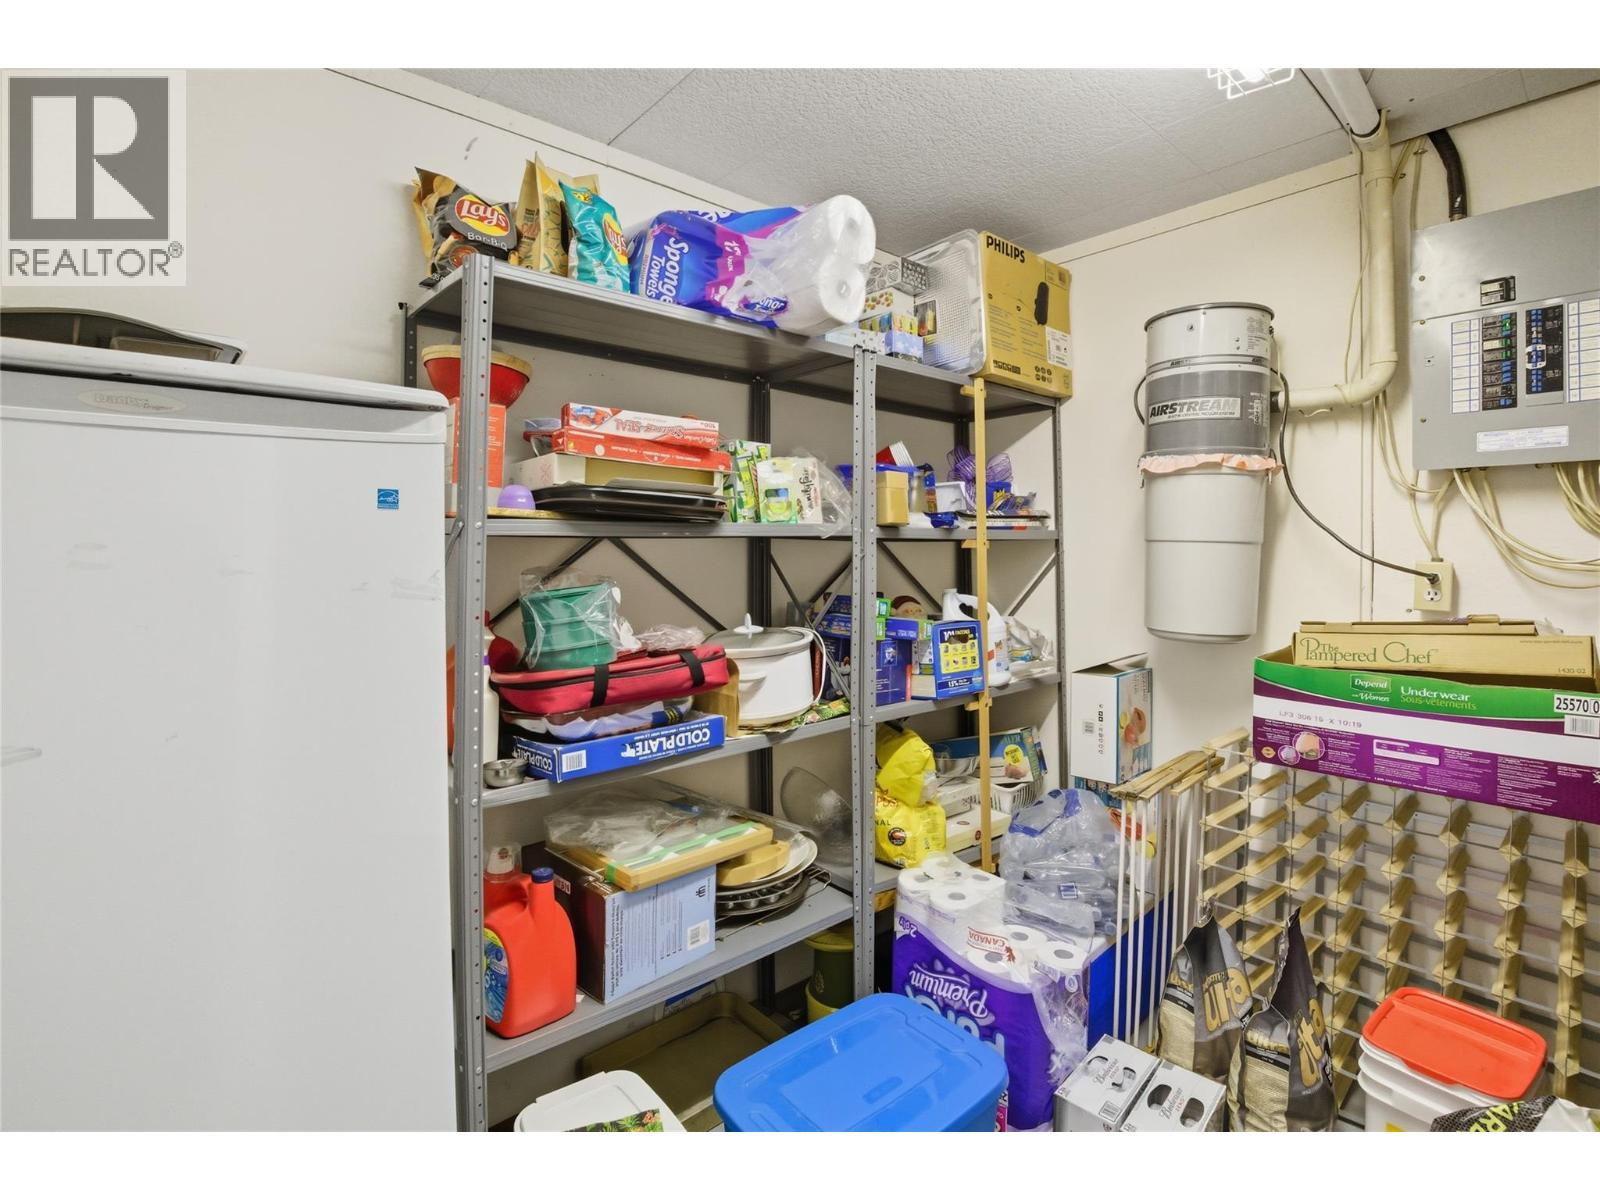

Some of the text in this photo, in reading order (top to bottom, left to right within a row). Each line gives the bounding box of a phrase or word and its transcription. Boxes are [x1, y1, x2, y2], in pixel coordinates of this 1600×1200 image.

[985, 235, 1026, 264] PHILIPS
[645, 255, 666, 299] Towels
[658, 237, 690, 304] Sponge
[1149, 398, 1237, 419] AIRSTREAM
[1300, 637, 1432, 665] The Pampered Chef
[1354, 678, 1388, 691] Depend
[1400, 685, 1471, 702] Underwear
[1555, 697, 1589, 713] 25570
[635, 735, 676, 756] PLATE
[675, 727, 711, 747] COLD
[967, 930, 1008, 947] CANADA
[909, 967, 990, 1019] Premium
